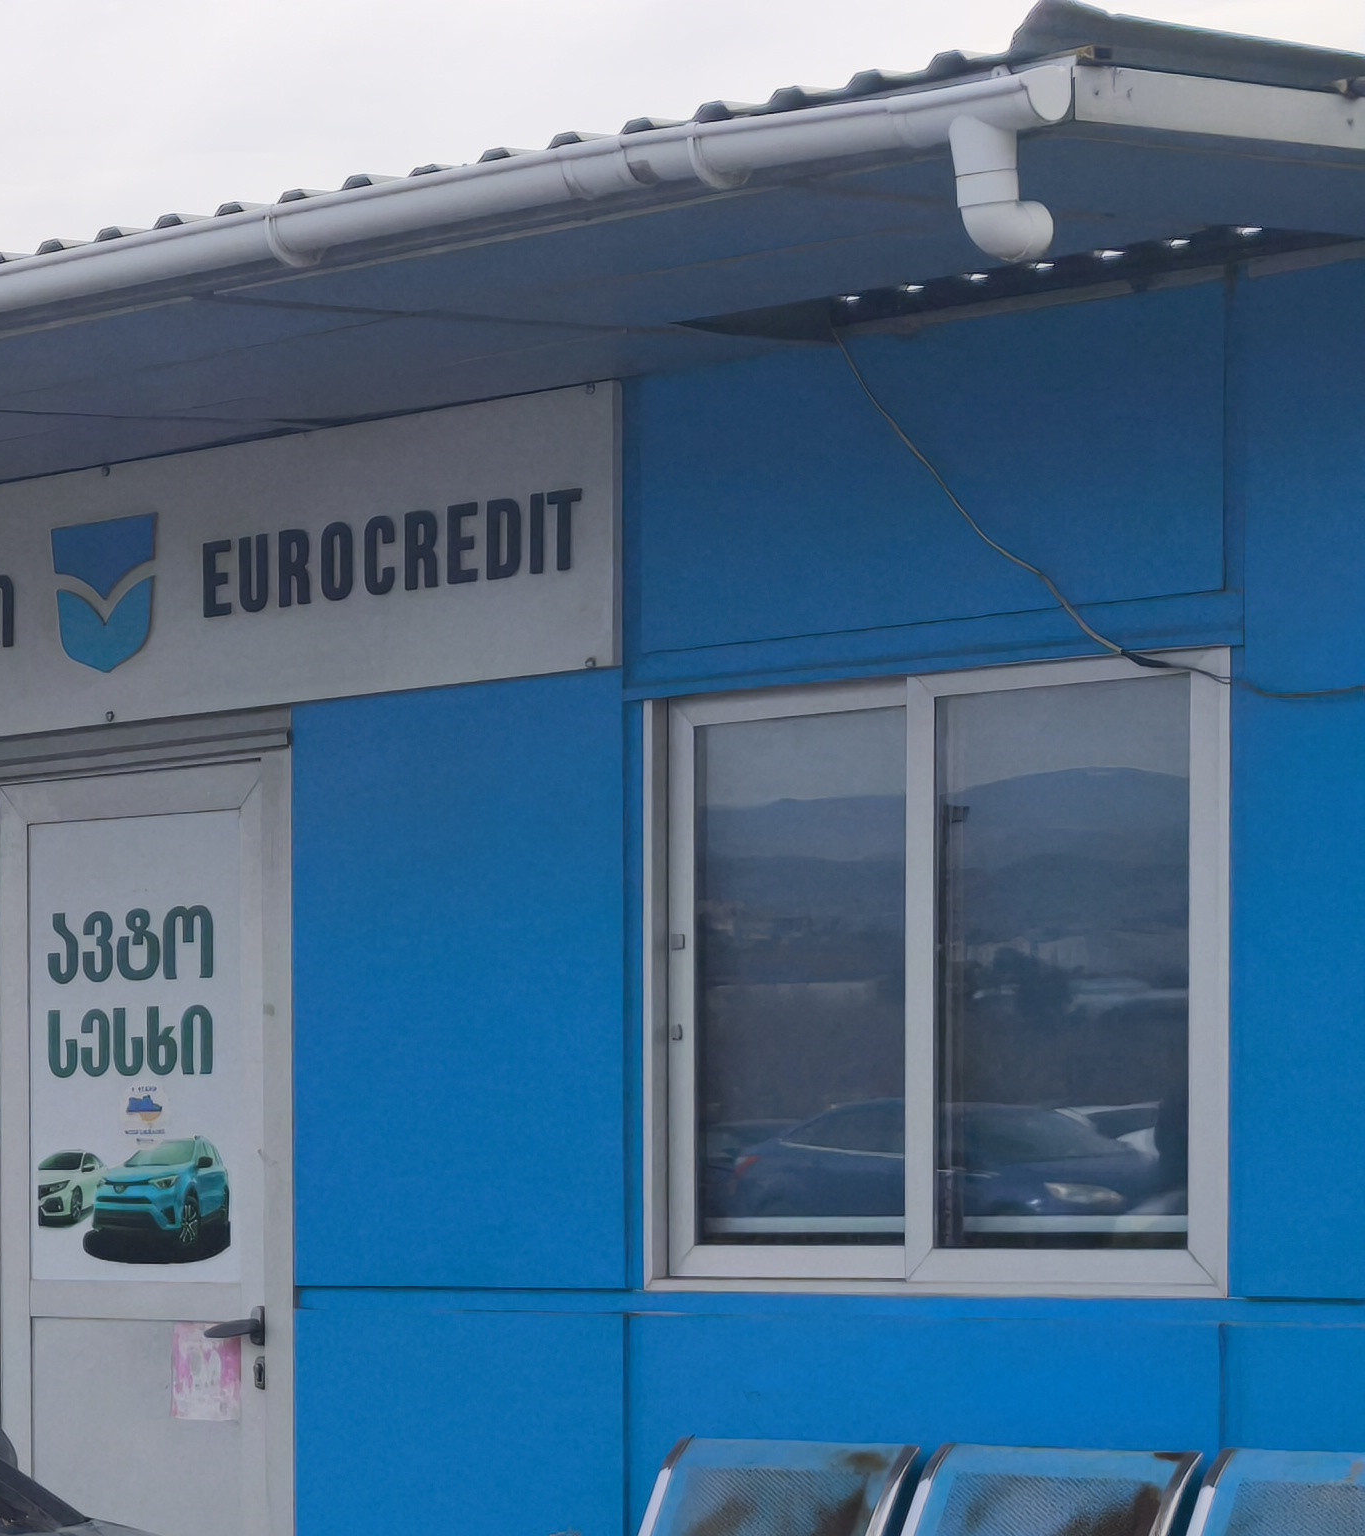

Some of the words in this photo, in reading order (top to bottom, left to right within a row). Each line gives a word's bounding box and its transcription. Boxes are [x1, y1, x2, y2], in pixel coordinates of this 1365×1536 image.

[202, 487, 584, 619] EUROCREDIT
[48, 904, 214, 984] ავტო
[48, 1004, 213, 1078] სესხი
